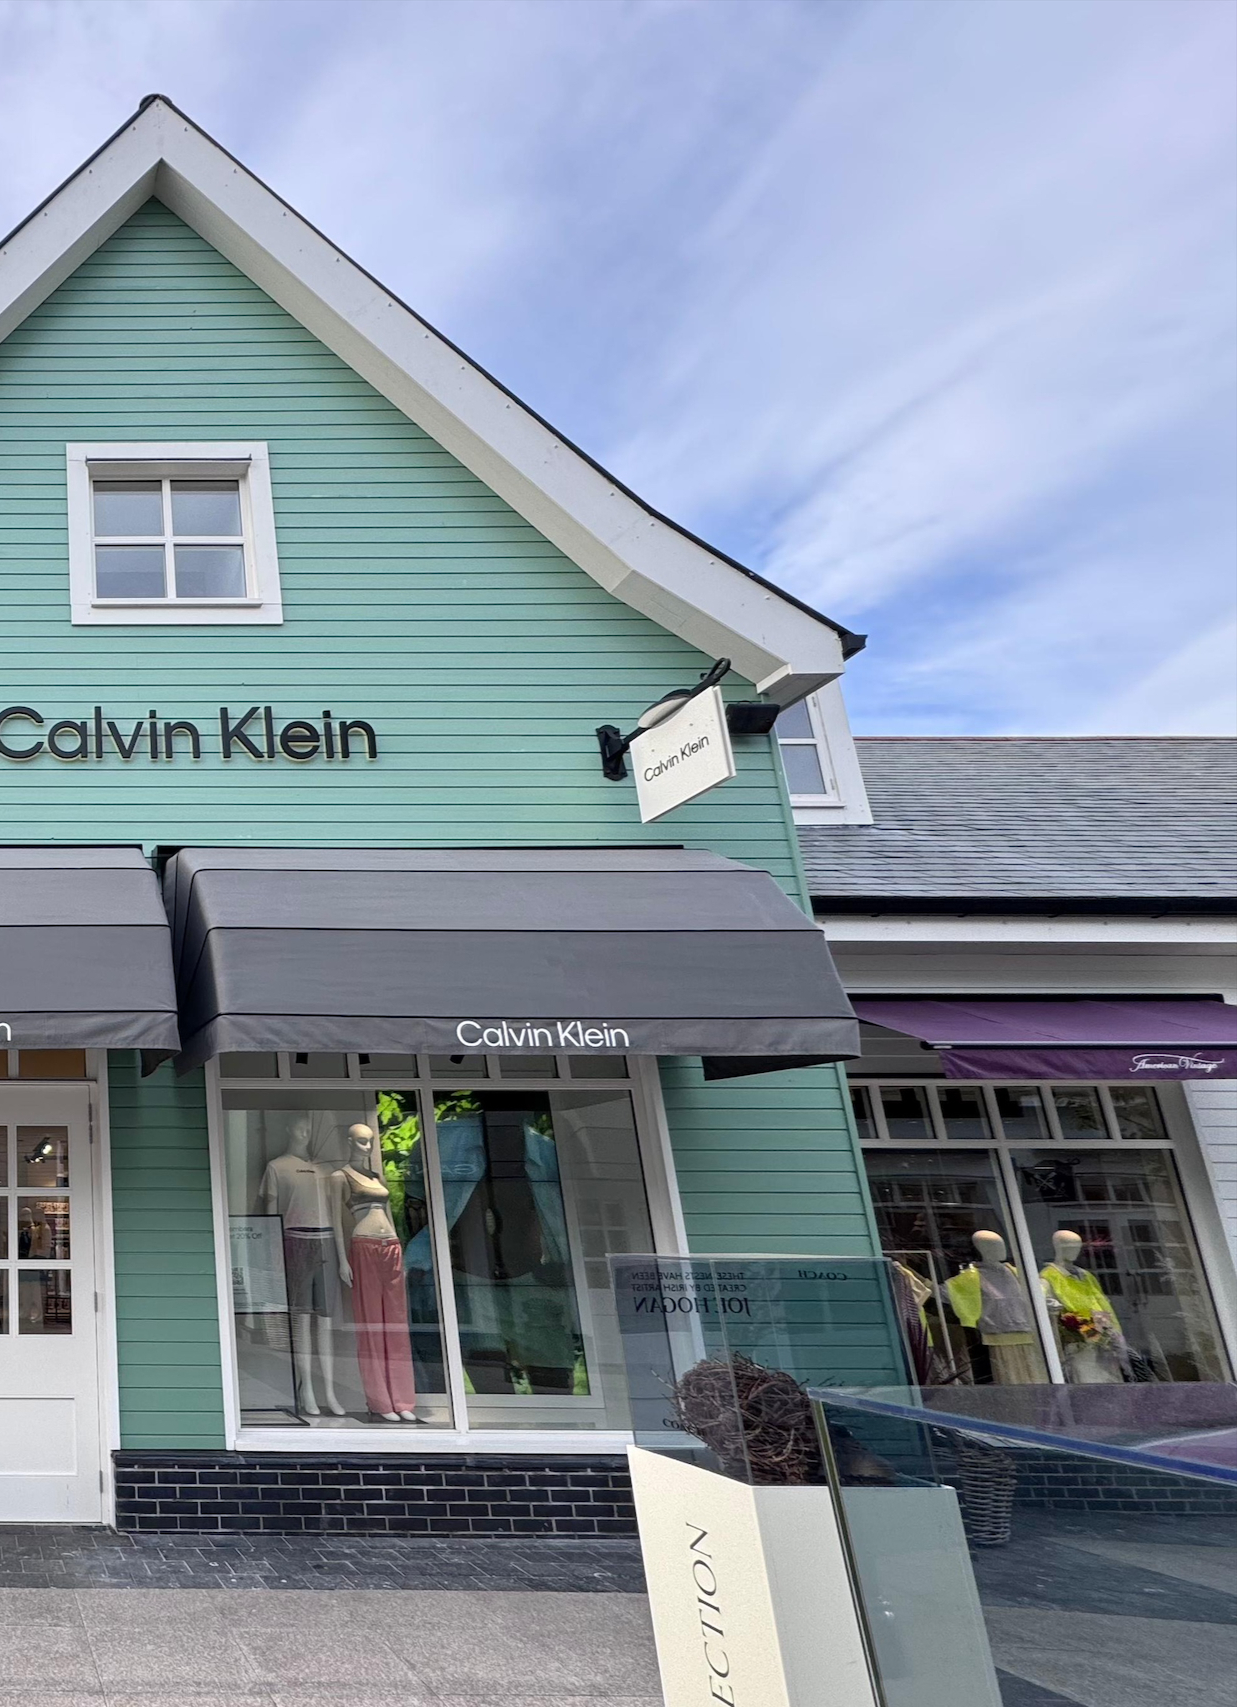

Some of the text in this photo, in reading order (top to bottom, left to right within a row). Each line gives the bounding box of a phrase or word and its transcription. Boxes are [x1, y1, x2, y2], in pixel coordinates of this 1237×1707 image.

[219, 705, 378, 760] Klein
[644, 735, 710, 782] Calvin Klein
[456, 1020, 630, 1047] Calvin Klein
[1129, 1054, 1179, 1073] American
[685, 1521, 736, 1707] ECTION
